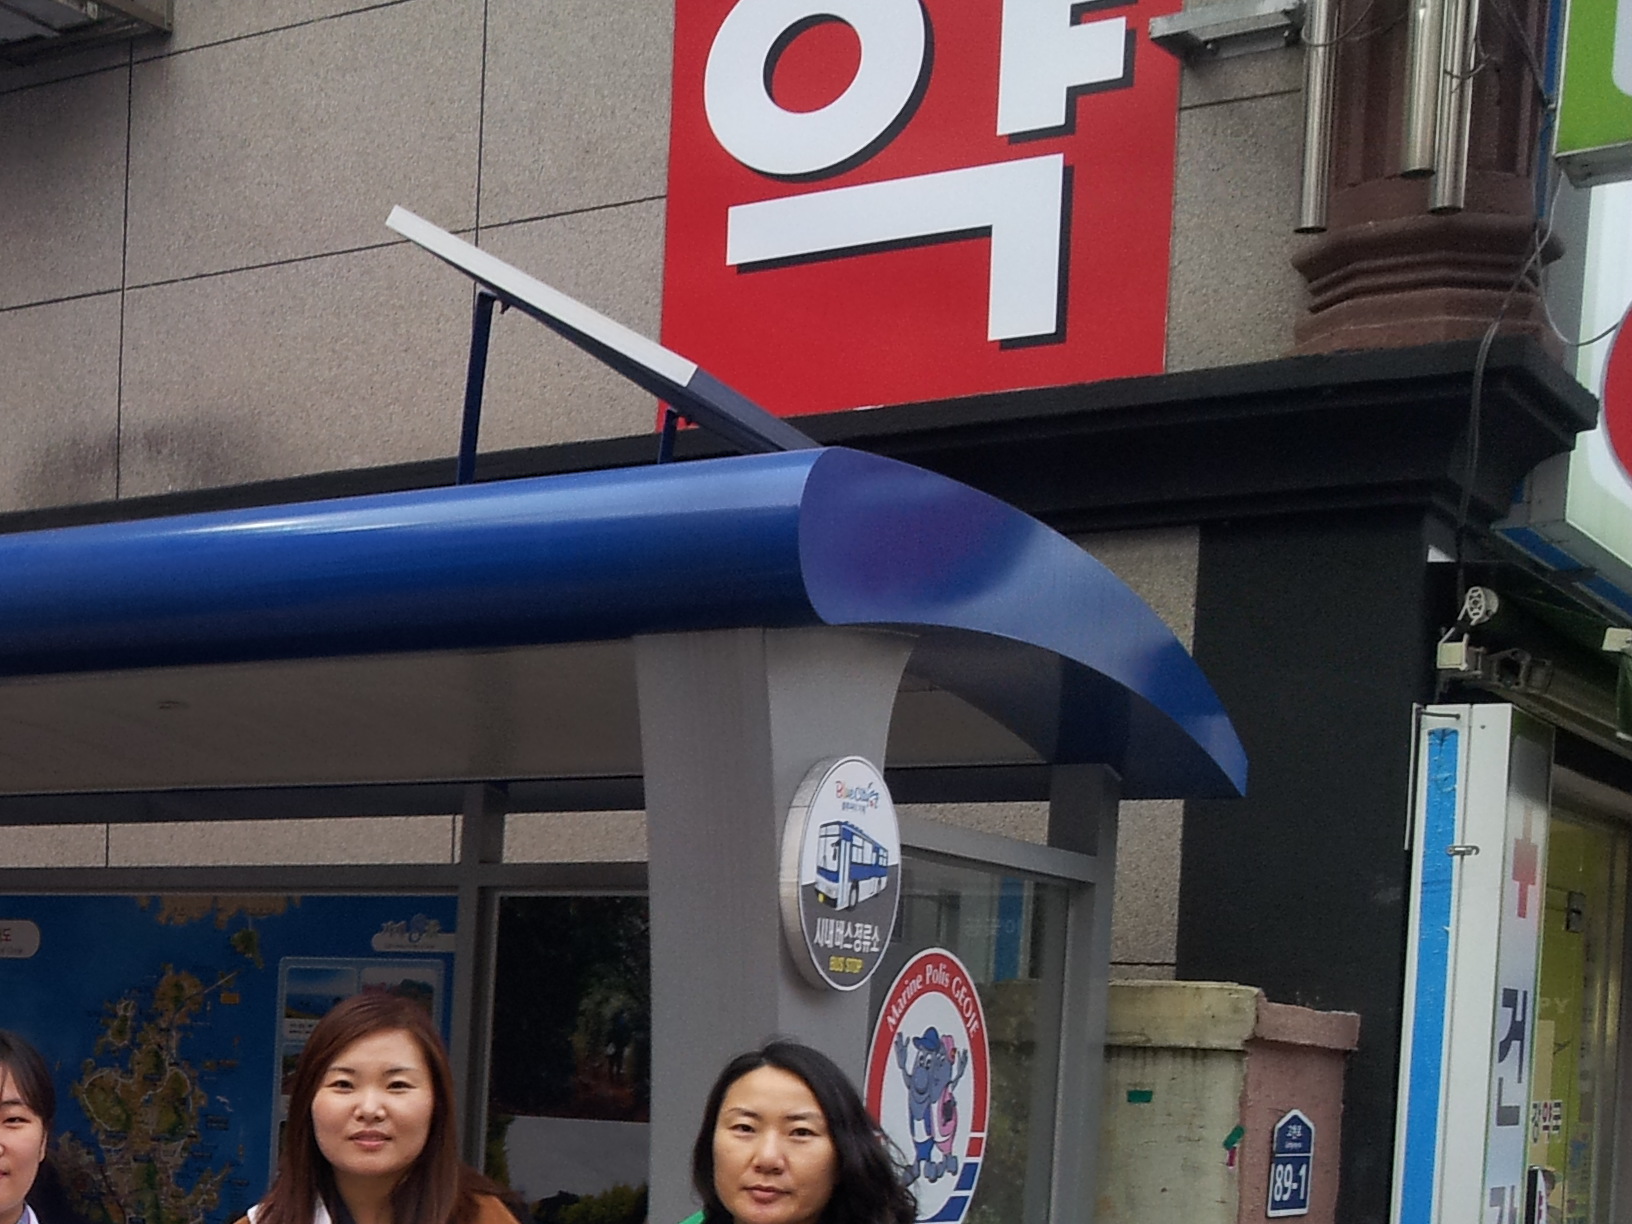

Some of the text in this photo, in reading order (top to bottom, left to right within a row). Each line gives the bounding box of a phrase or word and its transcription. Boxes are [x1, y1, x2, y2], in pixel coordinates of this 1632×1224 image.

[703, 0, 1133, 345] 약
[813, 917, 880, 953] 시내버스정류소
[886, 962, 980, 1039] Marine Polis GEOJE
